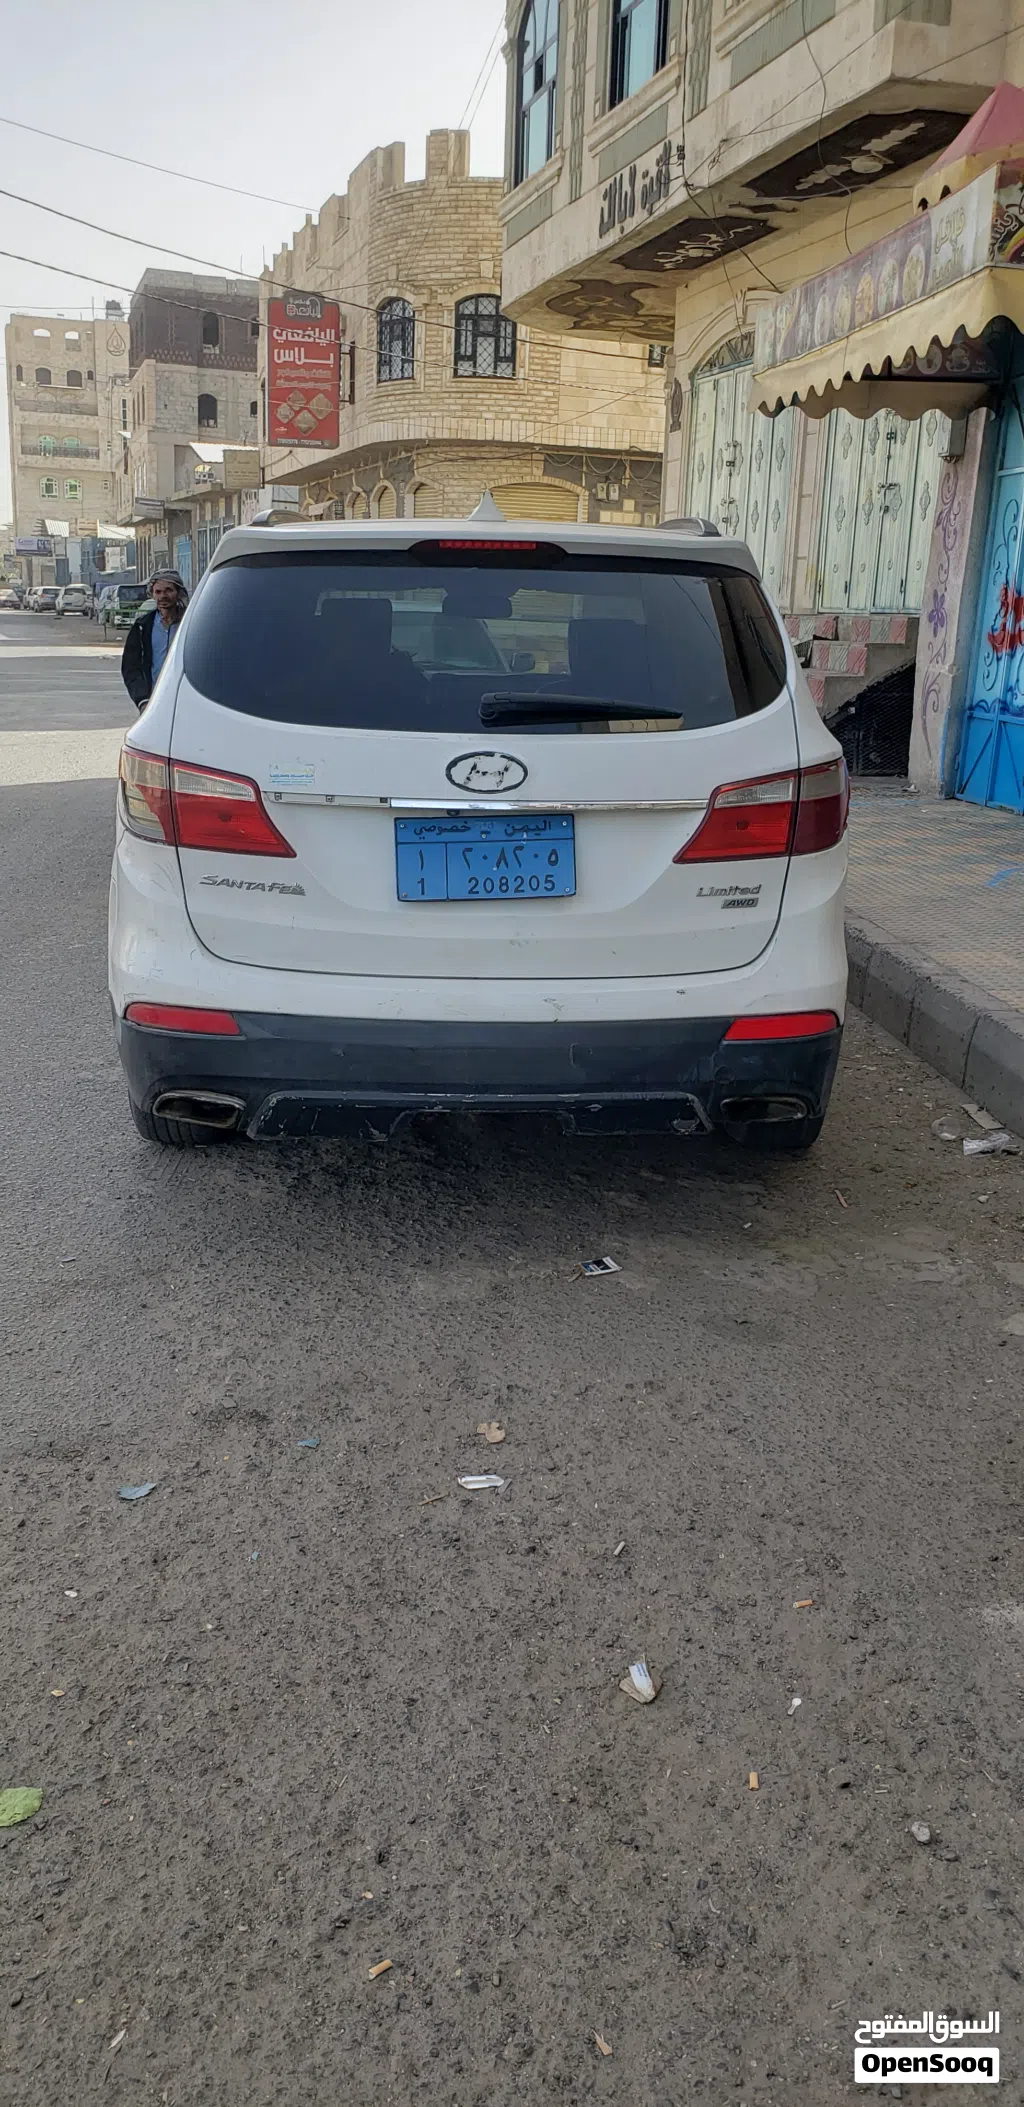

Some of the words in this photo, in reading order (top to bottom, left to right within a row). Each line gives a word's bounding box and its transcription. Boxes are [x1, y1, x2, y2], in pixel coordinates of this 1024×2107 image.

[273, 327, 336, 346] اليافعي
[274, 347, 334, 368] بلاس
[414, 820, 472, 840] خصوصي
[505, 820, 552, 836] اليمن
[461, 845, 559, 871] ٢٠٨٢٠٥
[417, 877, 426, 896] 1
[467, 874, 557, 895] 208205
[696, 884, 762, 898] Limited
[726, 898, 756, 907] AWD
